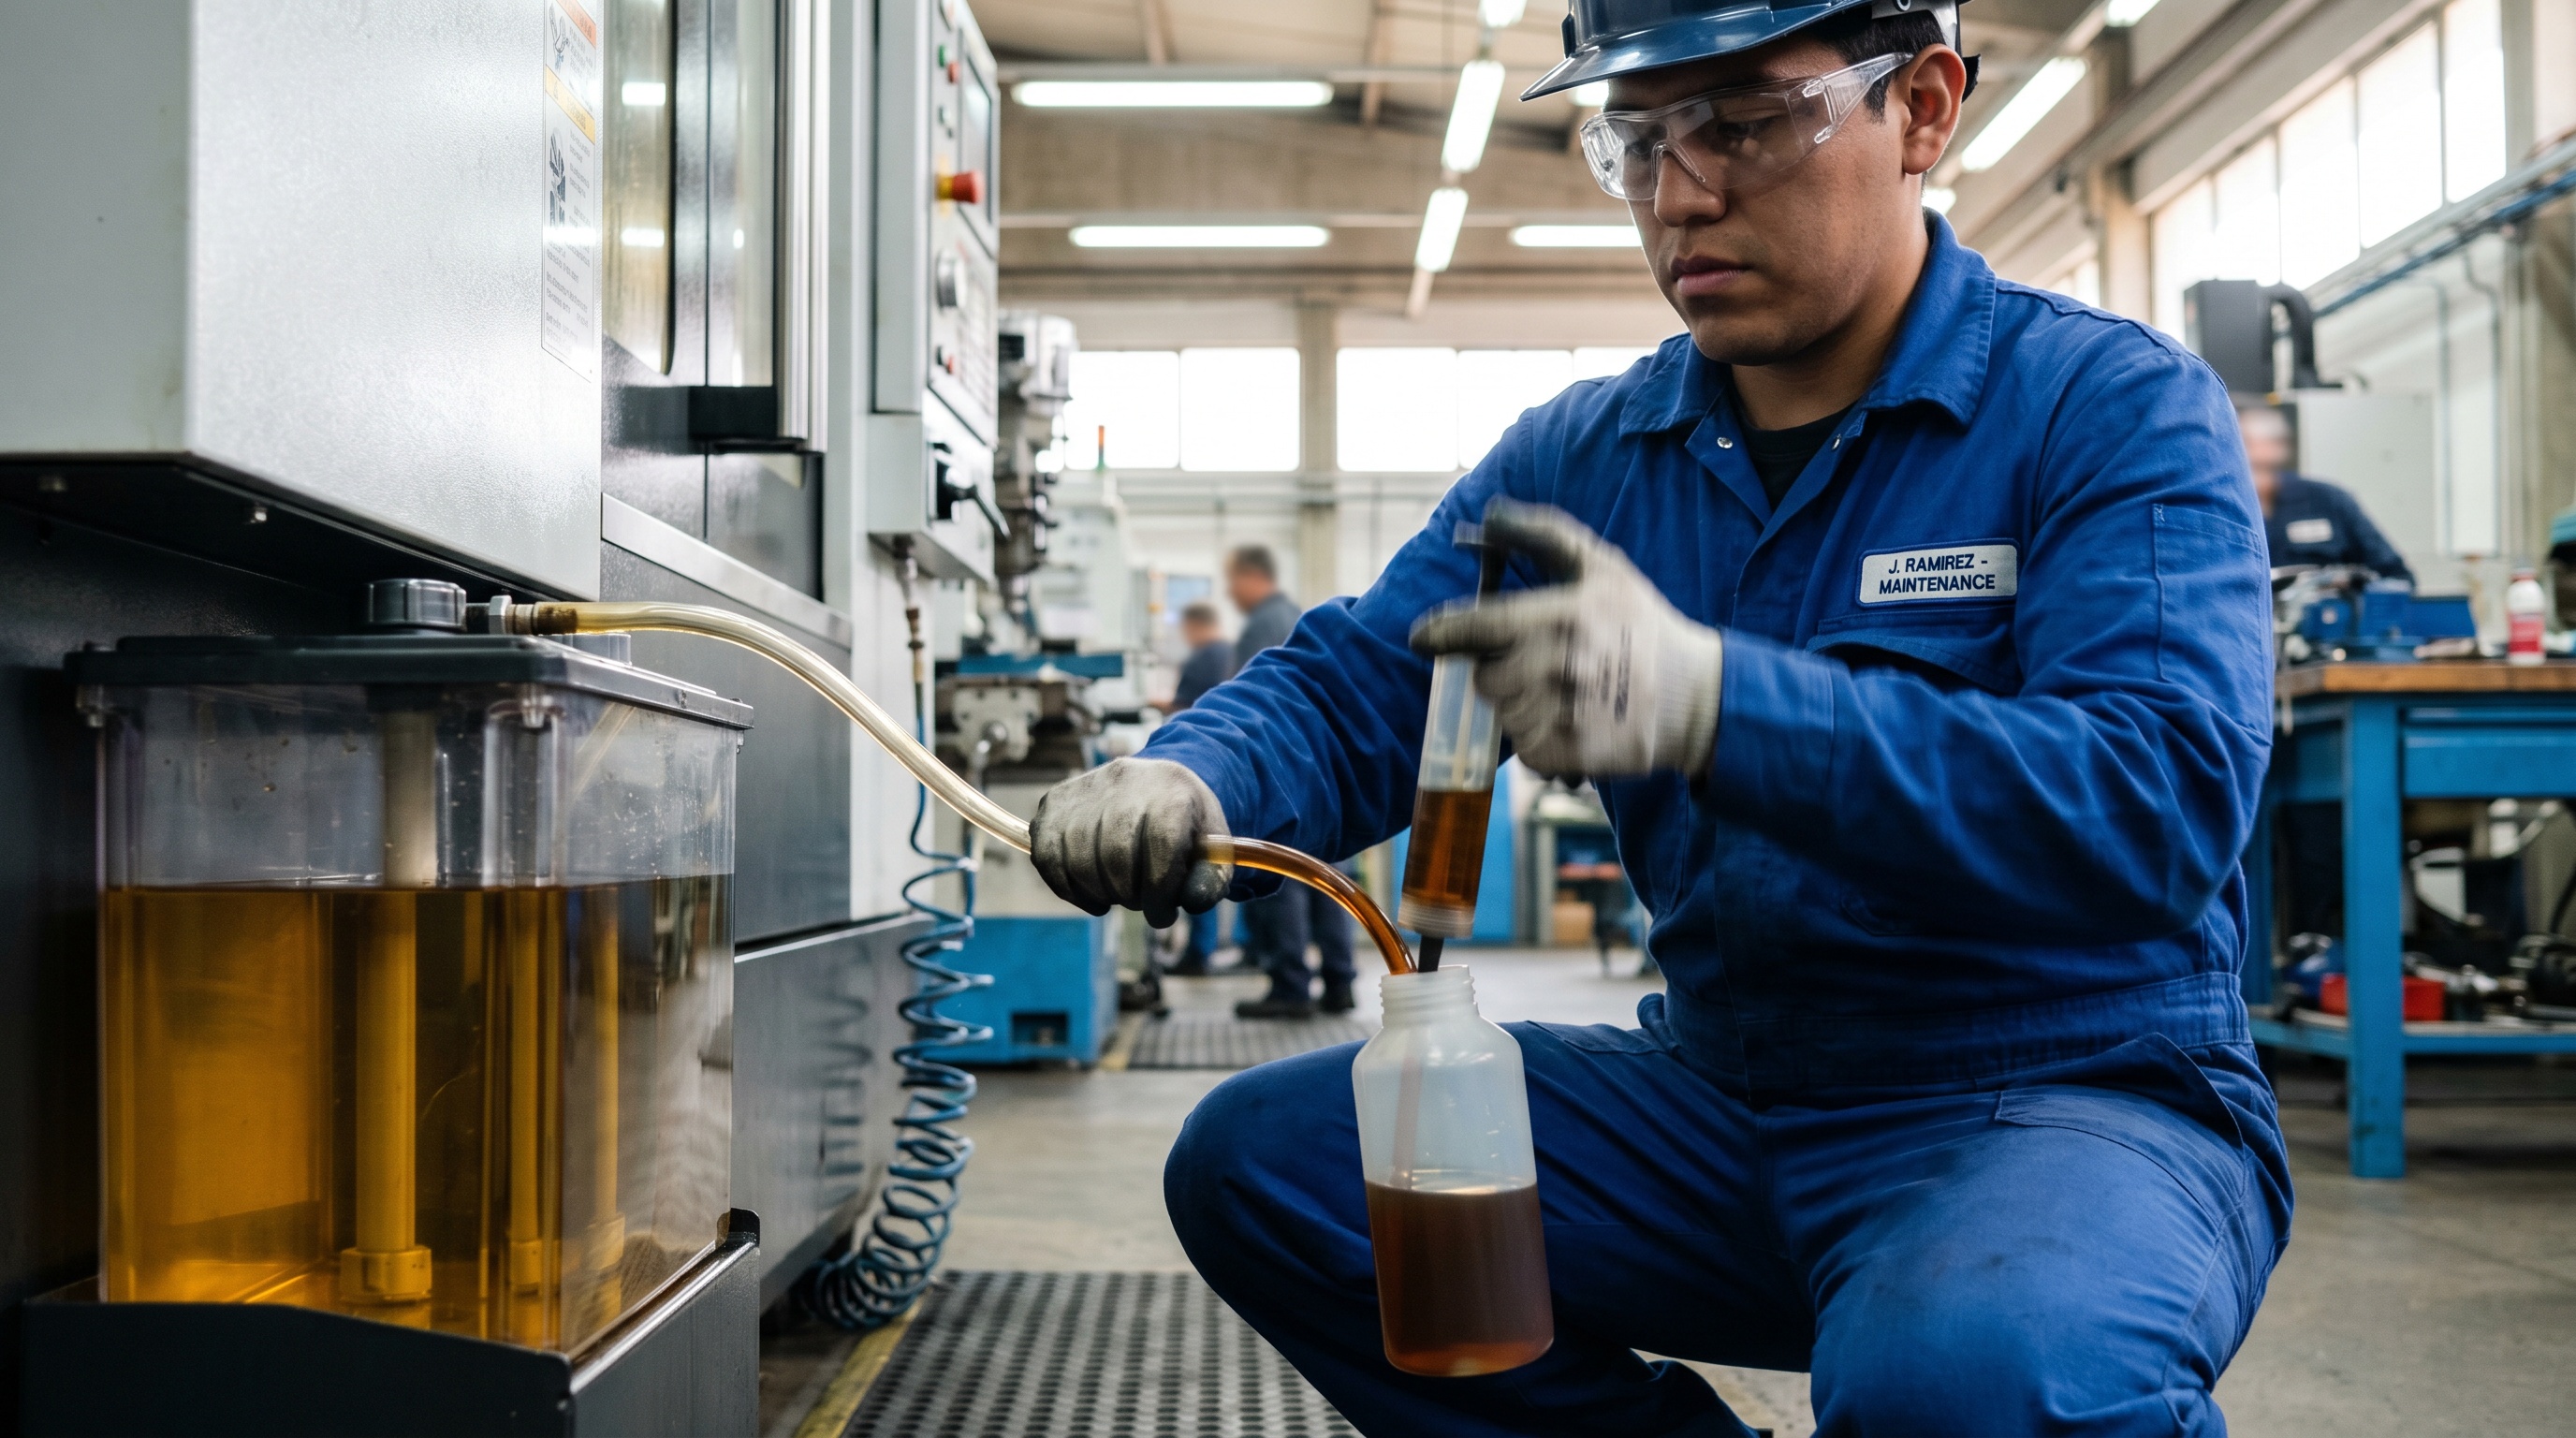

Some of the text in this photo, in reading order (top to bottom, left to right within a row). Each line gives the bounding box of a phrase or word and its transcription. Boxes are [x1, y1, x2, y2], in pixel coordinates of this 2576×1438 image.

[1888, 559, 1900, 574] J.
[1905, 553, 1975, 573] RAMIREZ
[1879, 574, 1996, 594] MAINTENANCE
